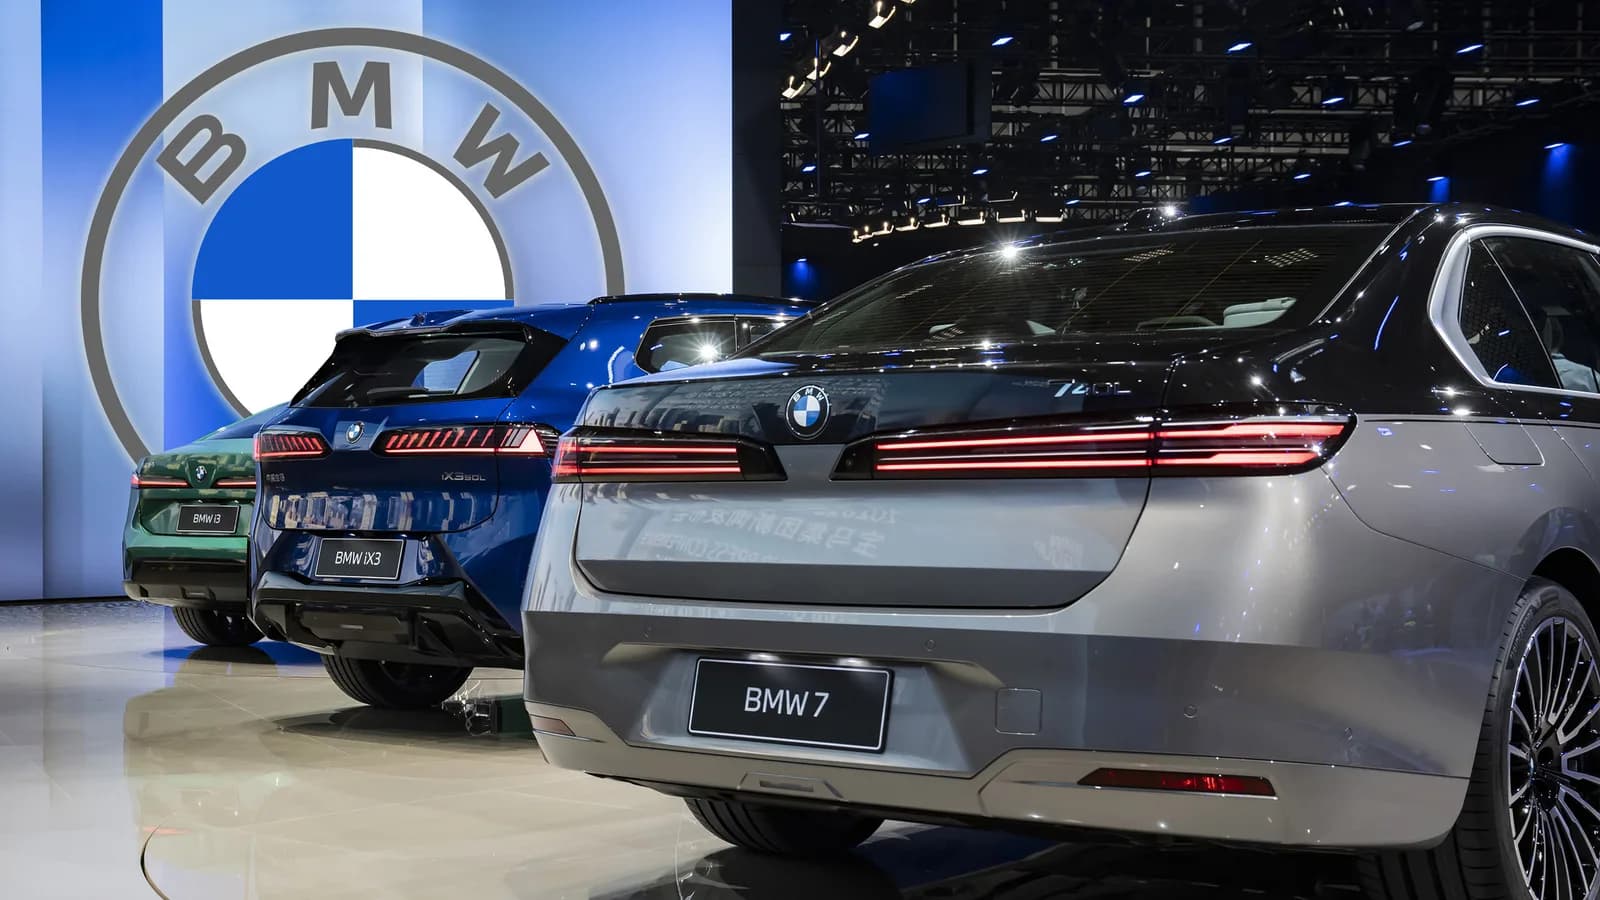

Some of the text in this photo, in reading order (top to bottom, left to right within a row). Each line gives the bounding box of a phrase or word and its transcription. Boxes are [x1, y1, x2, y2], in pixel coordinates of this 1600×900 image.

[156, 61, 551, 205] BMW
[793, 387, 825, 402] BMW
[193, 513, 221, 524] BMW i3
[335, 551, 382, 566] BMW iX3
[744, 686, 829, 718] BMW 7
